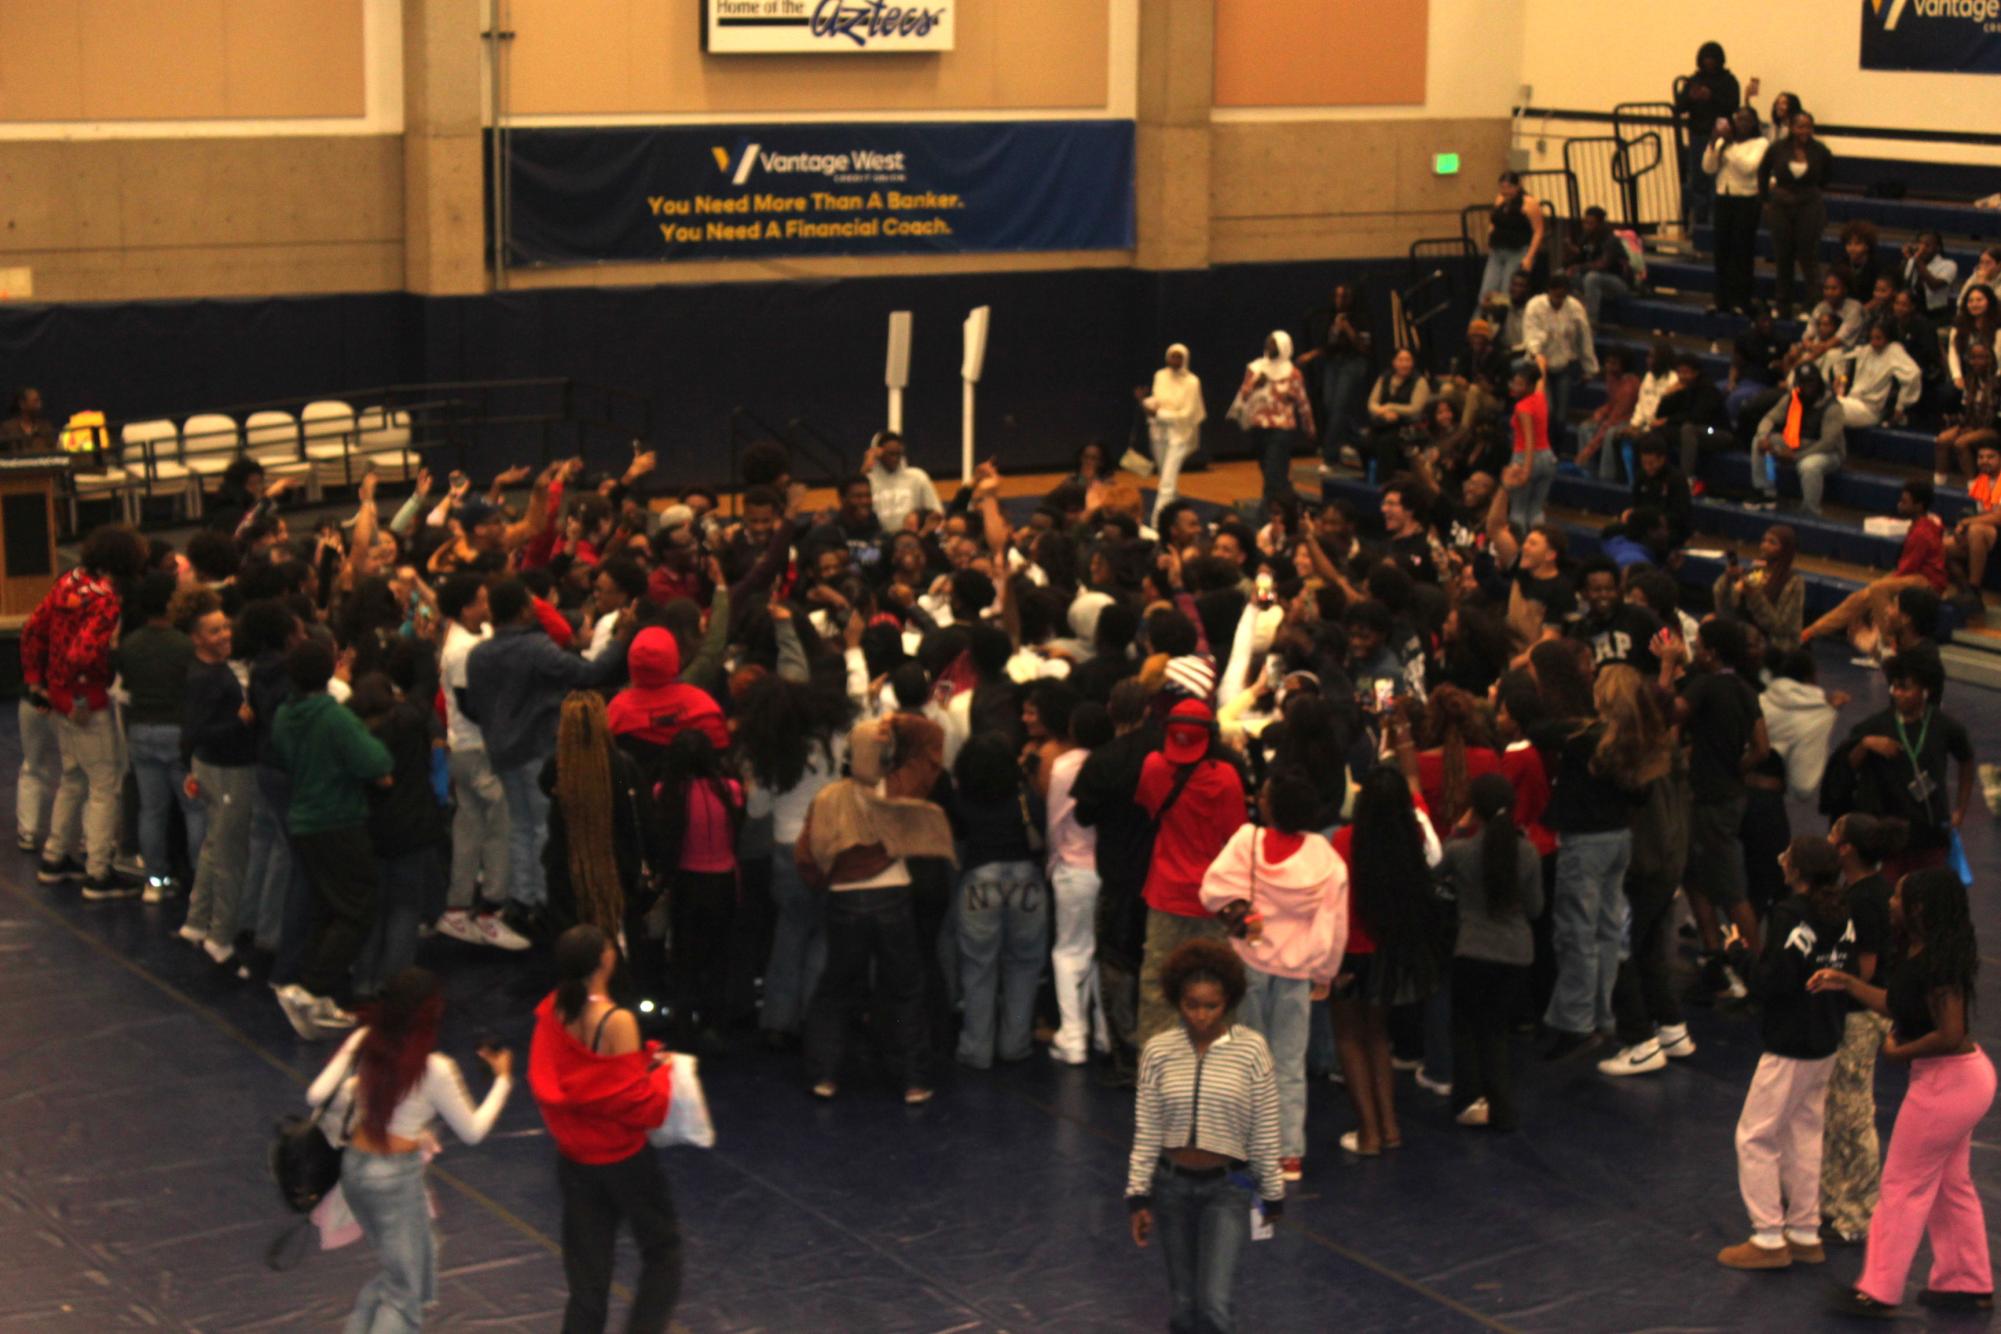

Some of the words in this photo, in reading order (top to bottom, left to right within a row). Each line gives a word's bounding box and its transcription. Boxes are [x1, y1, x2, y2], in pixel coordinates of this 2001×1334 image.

[716, 0, 759, 14] Home
[763, 0, 778, 14] of
[781, 0, 804, 14] the
[1913, 0, 2000, 22] Vantage
[760, 152, 849, 176] Vantage
[851, 150, 906, 171] West
[647, 195, 691, 216] You
[694, 194, 749, 214] Need
[753, 192, 807, 213] More
[810, 191, 863, 211] Than
[866, 190, 883, 209] A
[887, 190, 965, 210] Banker.
[660, 222, 702, 242] You
[706, 220, 762, 240] Need
[765, 219, 782, 239] A
[785, 217, 879, 238] Financial
[882, 216, 954, 236] Coach.
[967, 881, 1041, 913] NYC
